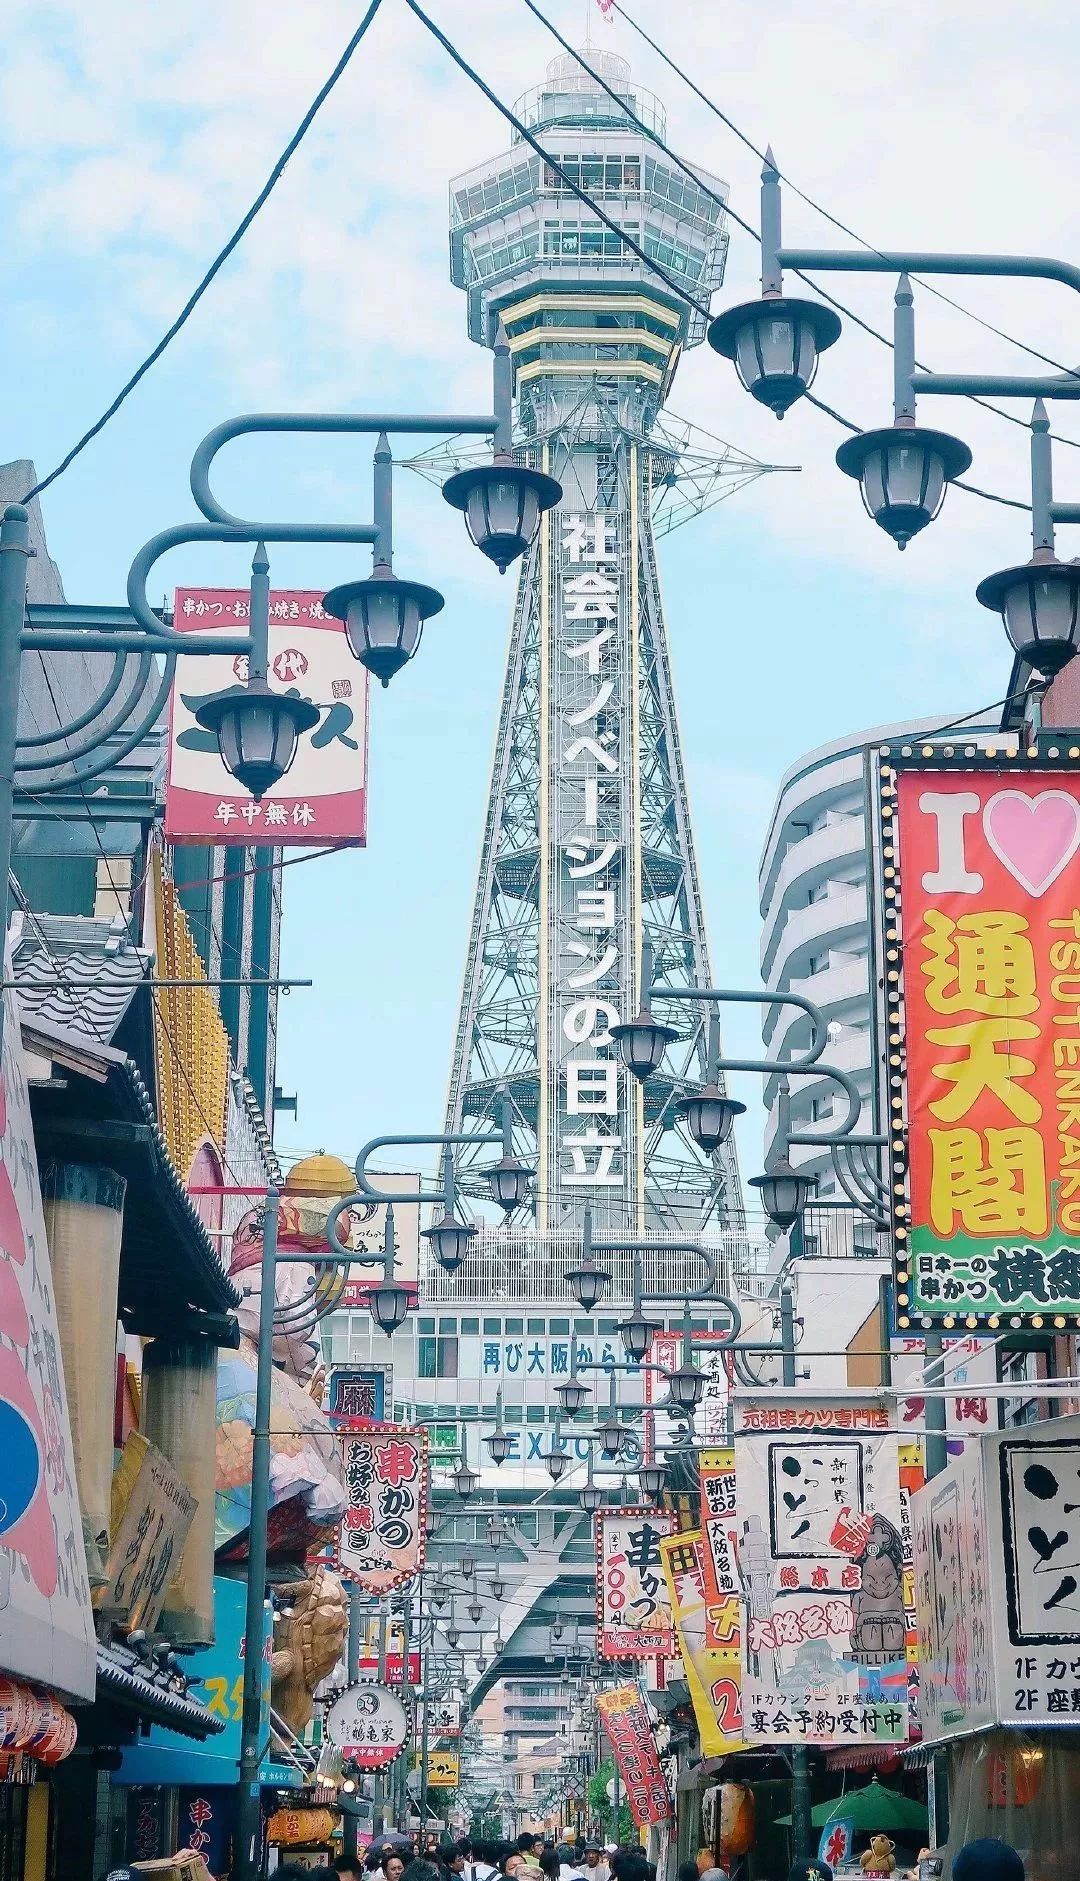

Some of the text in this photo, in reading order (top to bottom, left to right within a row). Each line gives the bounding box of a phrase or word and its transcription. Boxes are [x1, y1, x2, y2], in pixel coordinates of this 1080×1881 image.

[213, 801, 317, 827] 年中無休
[561, 514, 623, 1186] 社会イノベーションの日立
[922, 908, 1048, 1238] 通天閣
[919, 1256, 987, 1273] 日本一の
[920, 1276, 987, 1300] 串かつ
[743, 1408, 889, 1429] 元祖串カツ専門店
[344, 1440, 374, 1550] お好み焼き
[376, 1440, 419, 1549] 串かつ
[625, 1523, 667, 1615] 串かつ
[711, 1521, 733, 1590] 大阪名物
[780, 1565, 862, 1588] 総本店
[748, 1601, 855, 1651] 大阪名物
[750, 1709, 903, 1735] 宴会予約受付中
